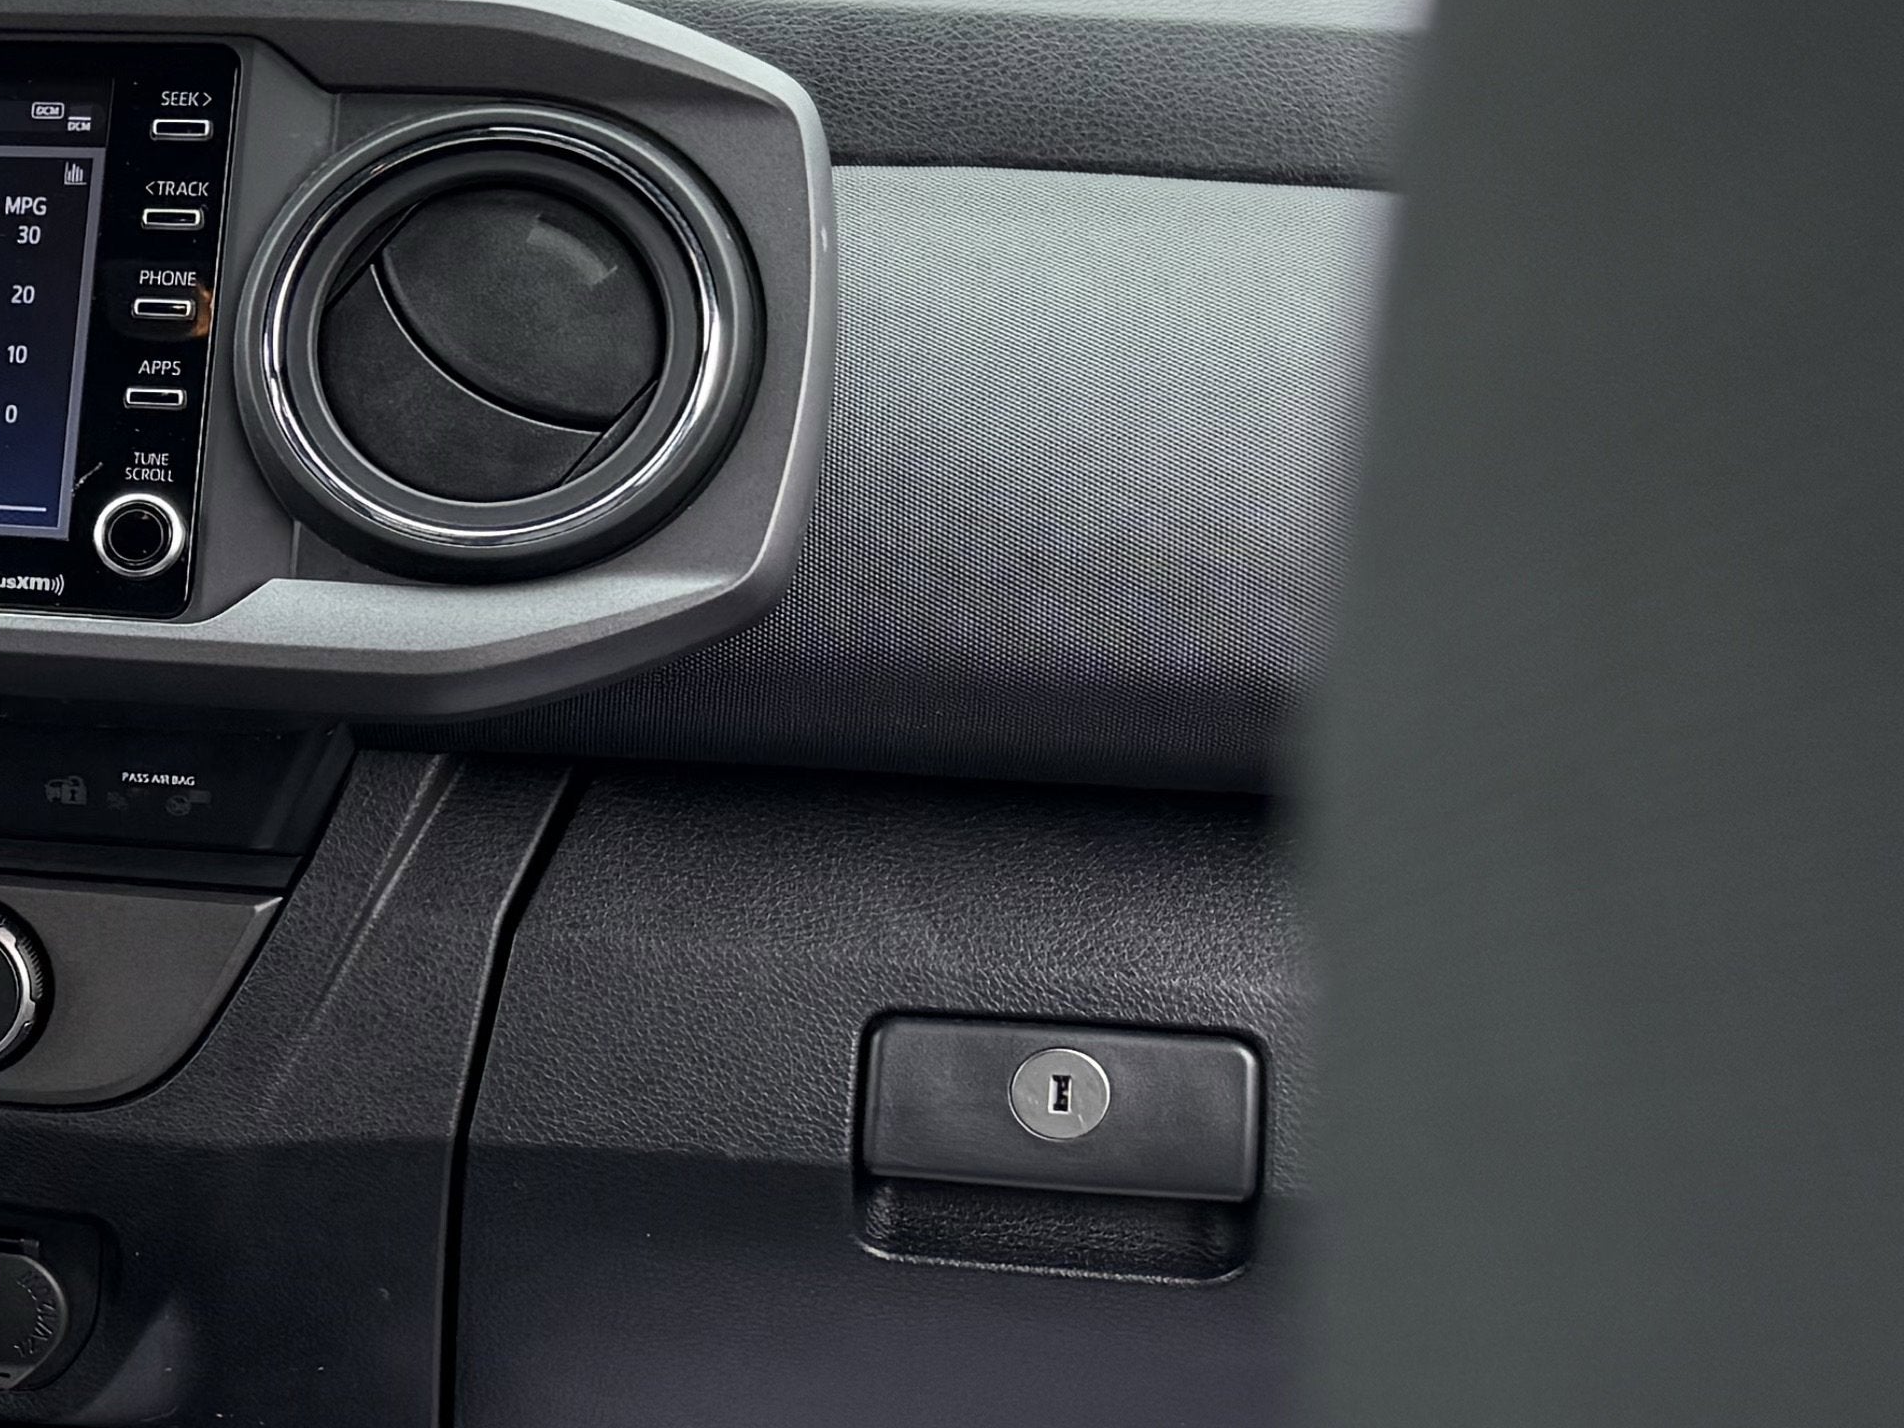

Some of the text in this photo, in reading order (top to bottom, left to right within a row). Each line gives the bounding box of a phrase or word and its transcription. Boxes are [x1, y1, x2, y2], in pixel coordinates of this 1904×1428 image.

[35, 106, 60, 116] DCM
[67, 121, 91, 132] DCM
[5, 197, 47, 216] MPG
[16, 226, 41, 245] 30
[139, 270, 197, 287] PHONE
[10, 285, 35, 305] 20
[7, 346, 28, 364] 10
[138, 360, 182, 376] APPS
[4, 405, 18, 424] 0
[133, 452, 169, 467] TUNE
[124, 467, 174, 483] SCROLL
[122, 772, 149, 784] PASS
[171, 775, 195, 787] BAG
